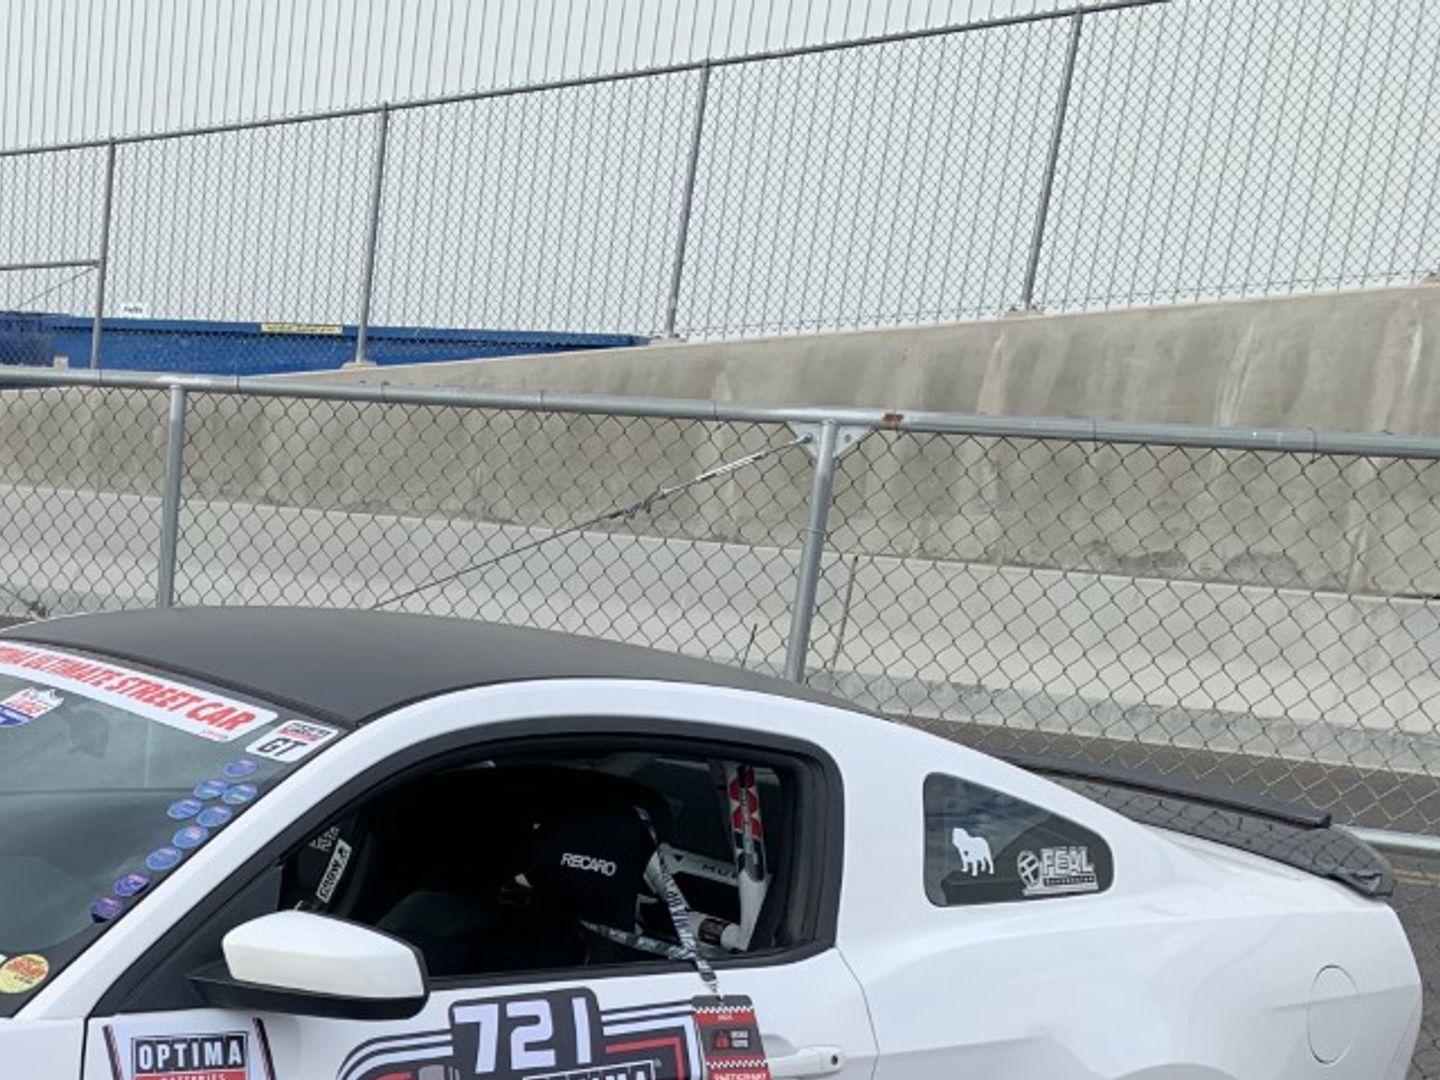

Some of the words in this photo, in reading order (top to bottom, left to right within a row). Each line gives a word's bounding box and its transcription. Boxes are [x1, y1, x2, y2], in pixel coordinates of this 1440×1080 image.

[106, 676, 205, 712] STREET
[185, 702, 256, 732] CAR
[257, 738, 307, 757] GT
[560, 852, 617, 876] RECARO
[453, 997, 591, 1074] 721
[138, 1039, 242, 1070] OPTIMA
